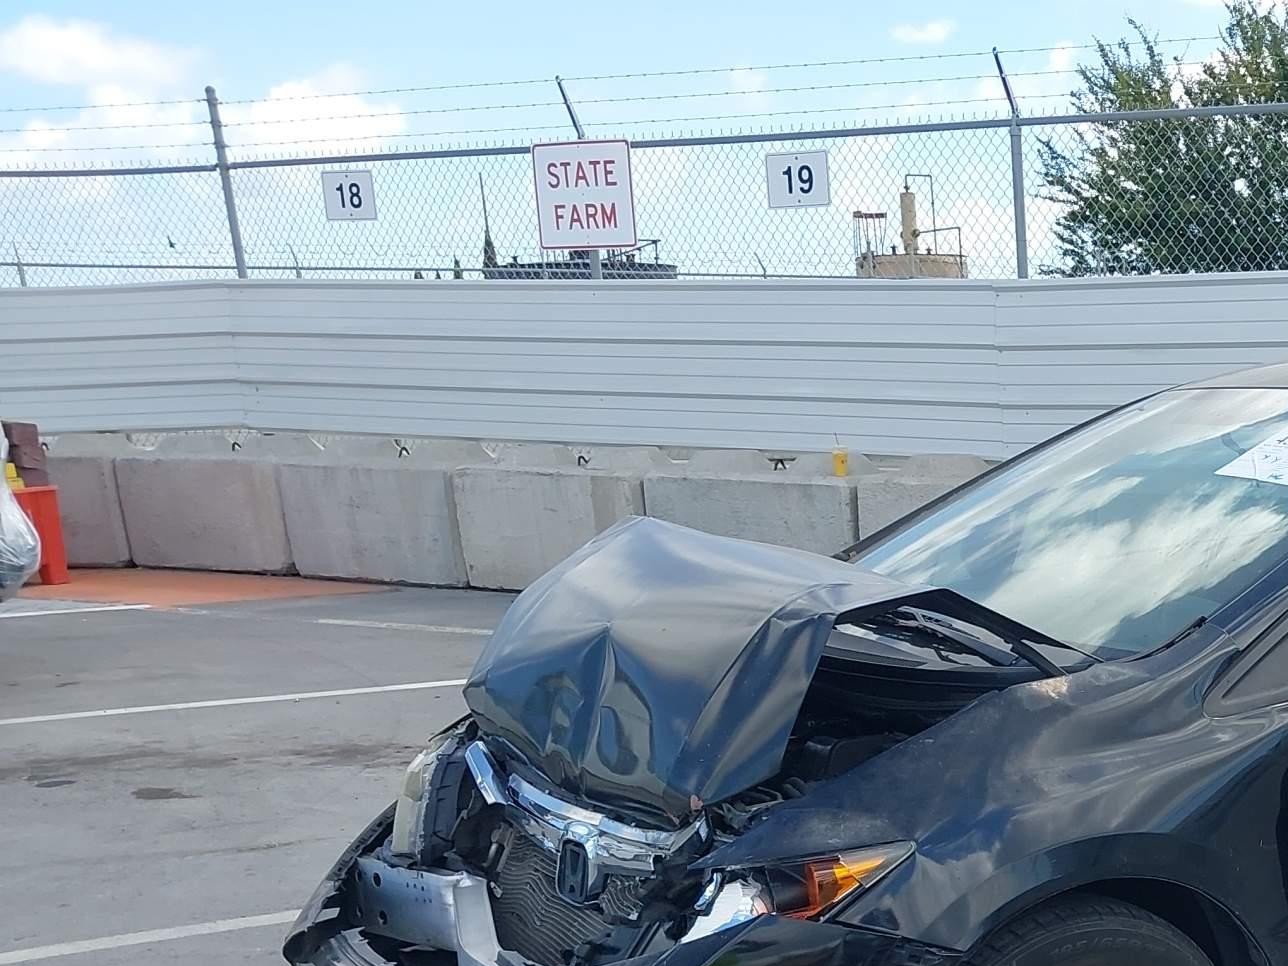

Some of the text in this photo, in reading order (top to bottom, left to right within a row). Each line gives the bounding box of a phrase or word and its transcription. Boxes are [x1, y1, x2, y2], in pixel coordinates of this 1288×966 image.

[547, 160, 618, 189] STATE
[782, 165, 814, 194] 19
[335, 182, 362, 209] 18
[553, 202, 618, 230] FARM
